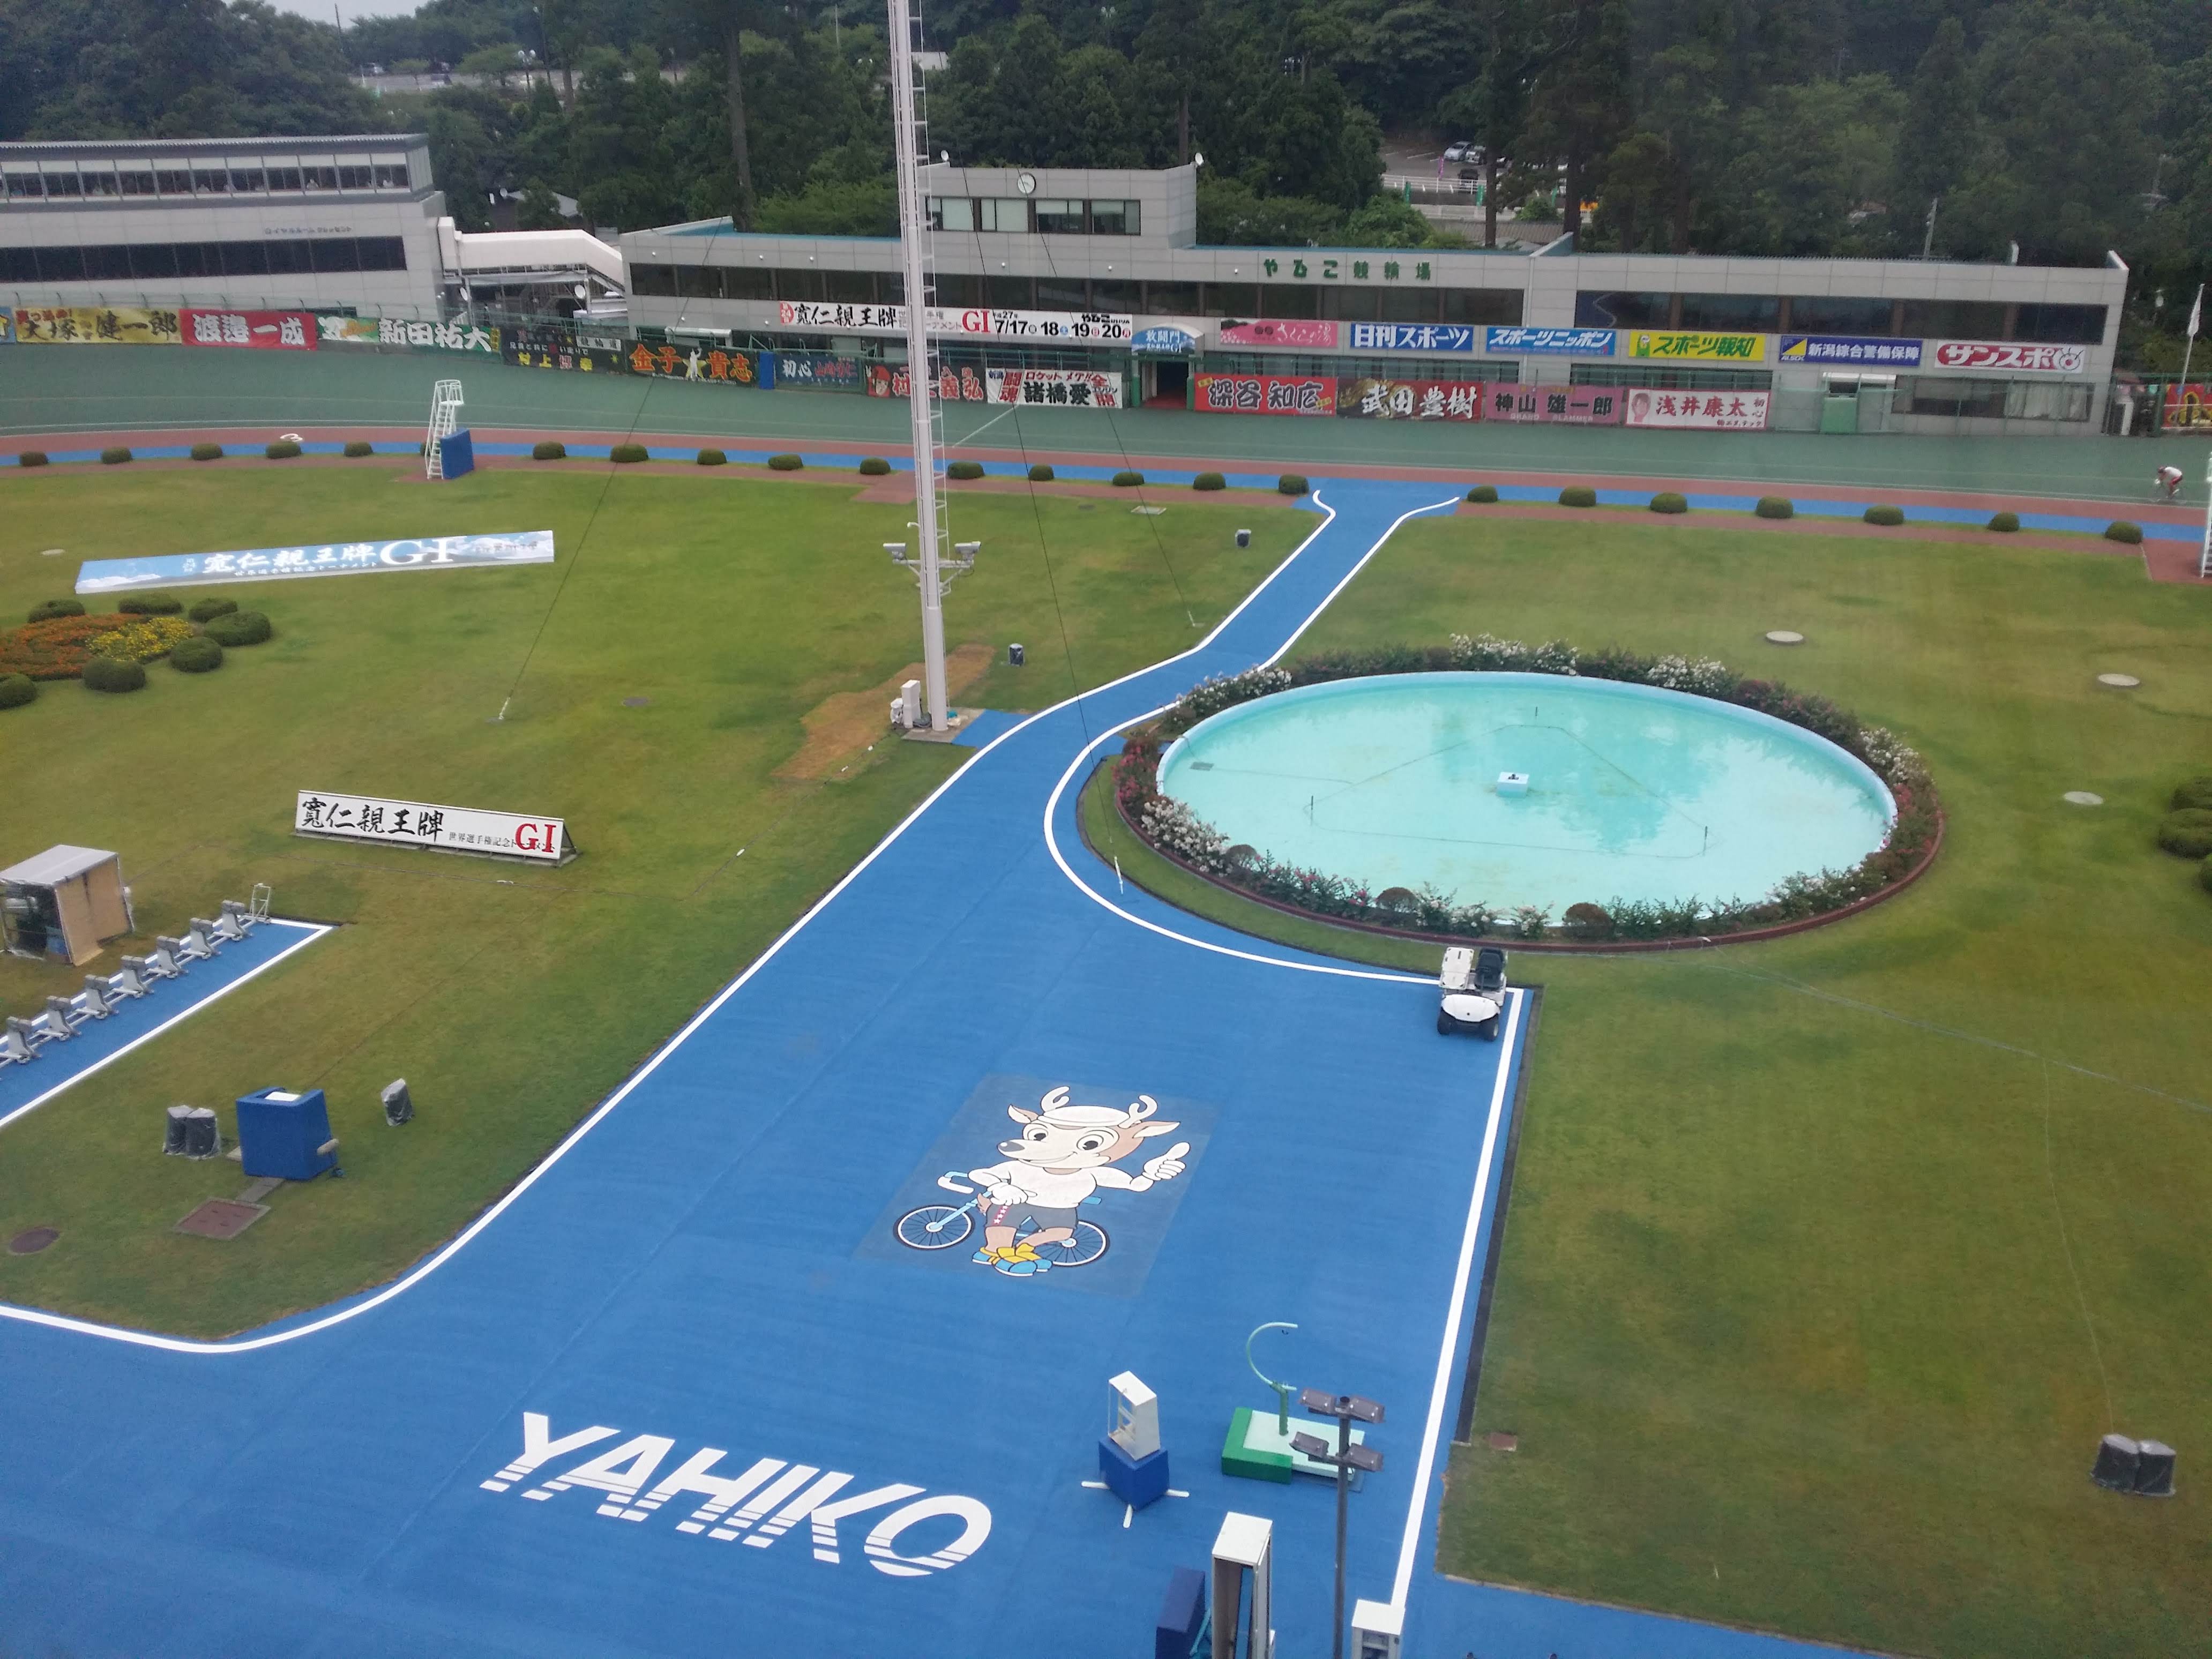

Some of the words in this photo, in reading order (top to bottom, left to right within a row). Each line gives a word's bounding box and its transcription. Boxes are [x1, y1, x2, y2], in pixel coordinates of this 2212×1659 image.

[1355, 324, 1470, 349] 日刊スポーツ
[1489, 329, 1613, 348] スポーツニッポン
[1653, 334, 1757, 357] スポーツ報知
[629, 343, 683, 373] 金子
[1946, 345, 2056, 369] サンスポ
[1026, 371, 1062, 381] ロケット
[1495, 393, 1613, 416] 神山雄一郎
[514, 823, 557, 854] GI
[479, 1411, 993, 1578] YAHIKO
